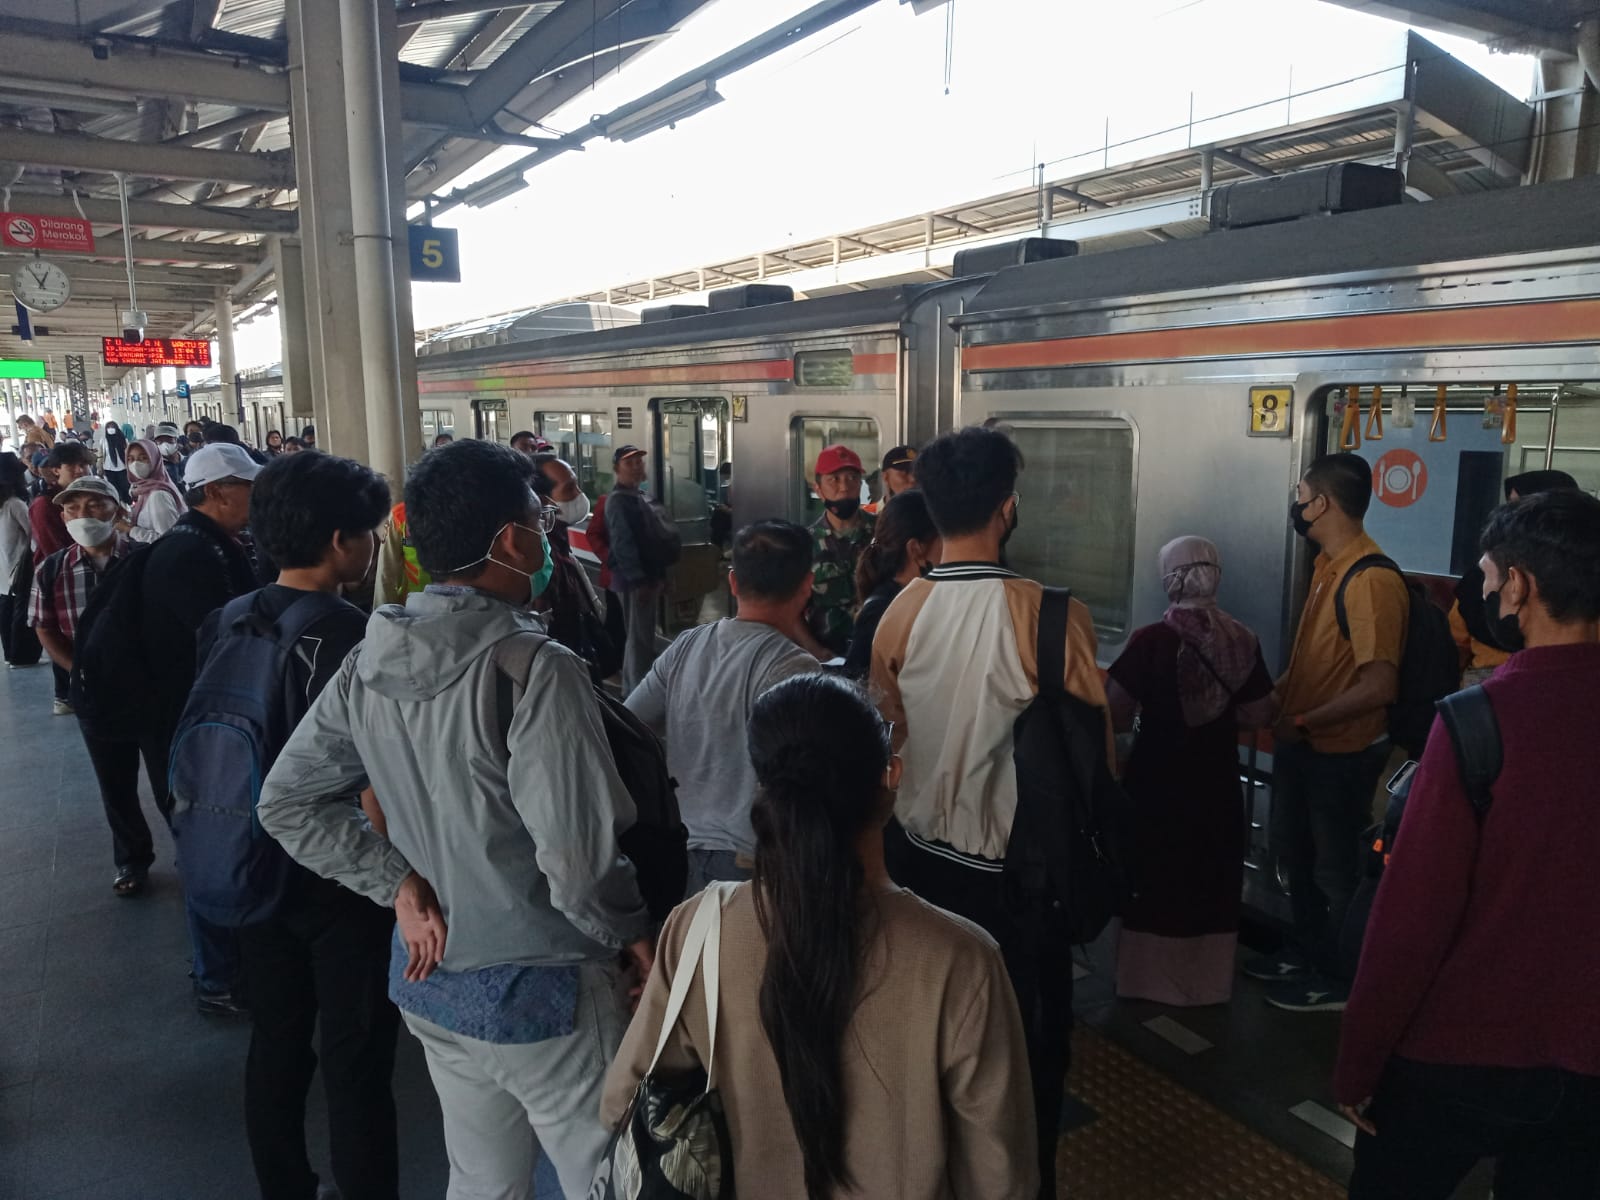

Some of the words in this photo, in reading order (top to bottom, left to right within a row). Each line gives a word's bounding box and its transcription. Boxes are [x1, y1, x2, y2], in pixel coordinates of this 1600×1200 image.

[40, 219, 84, 232] Dilarang
[42, 230, 88, 241] Merokok
[422, 239, 443, 269] 5
